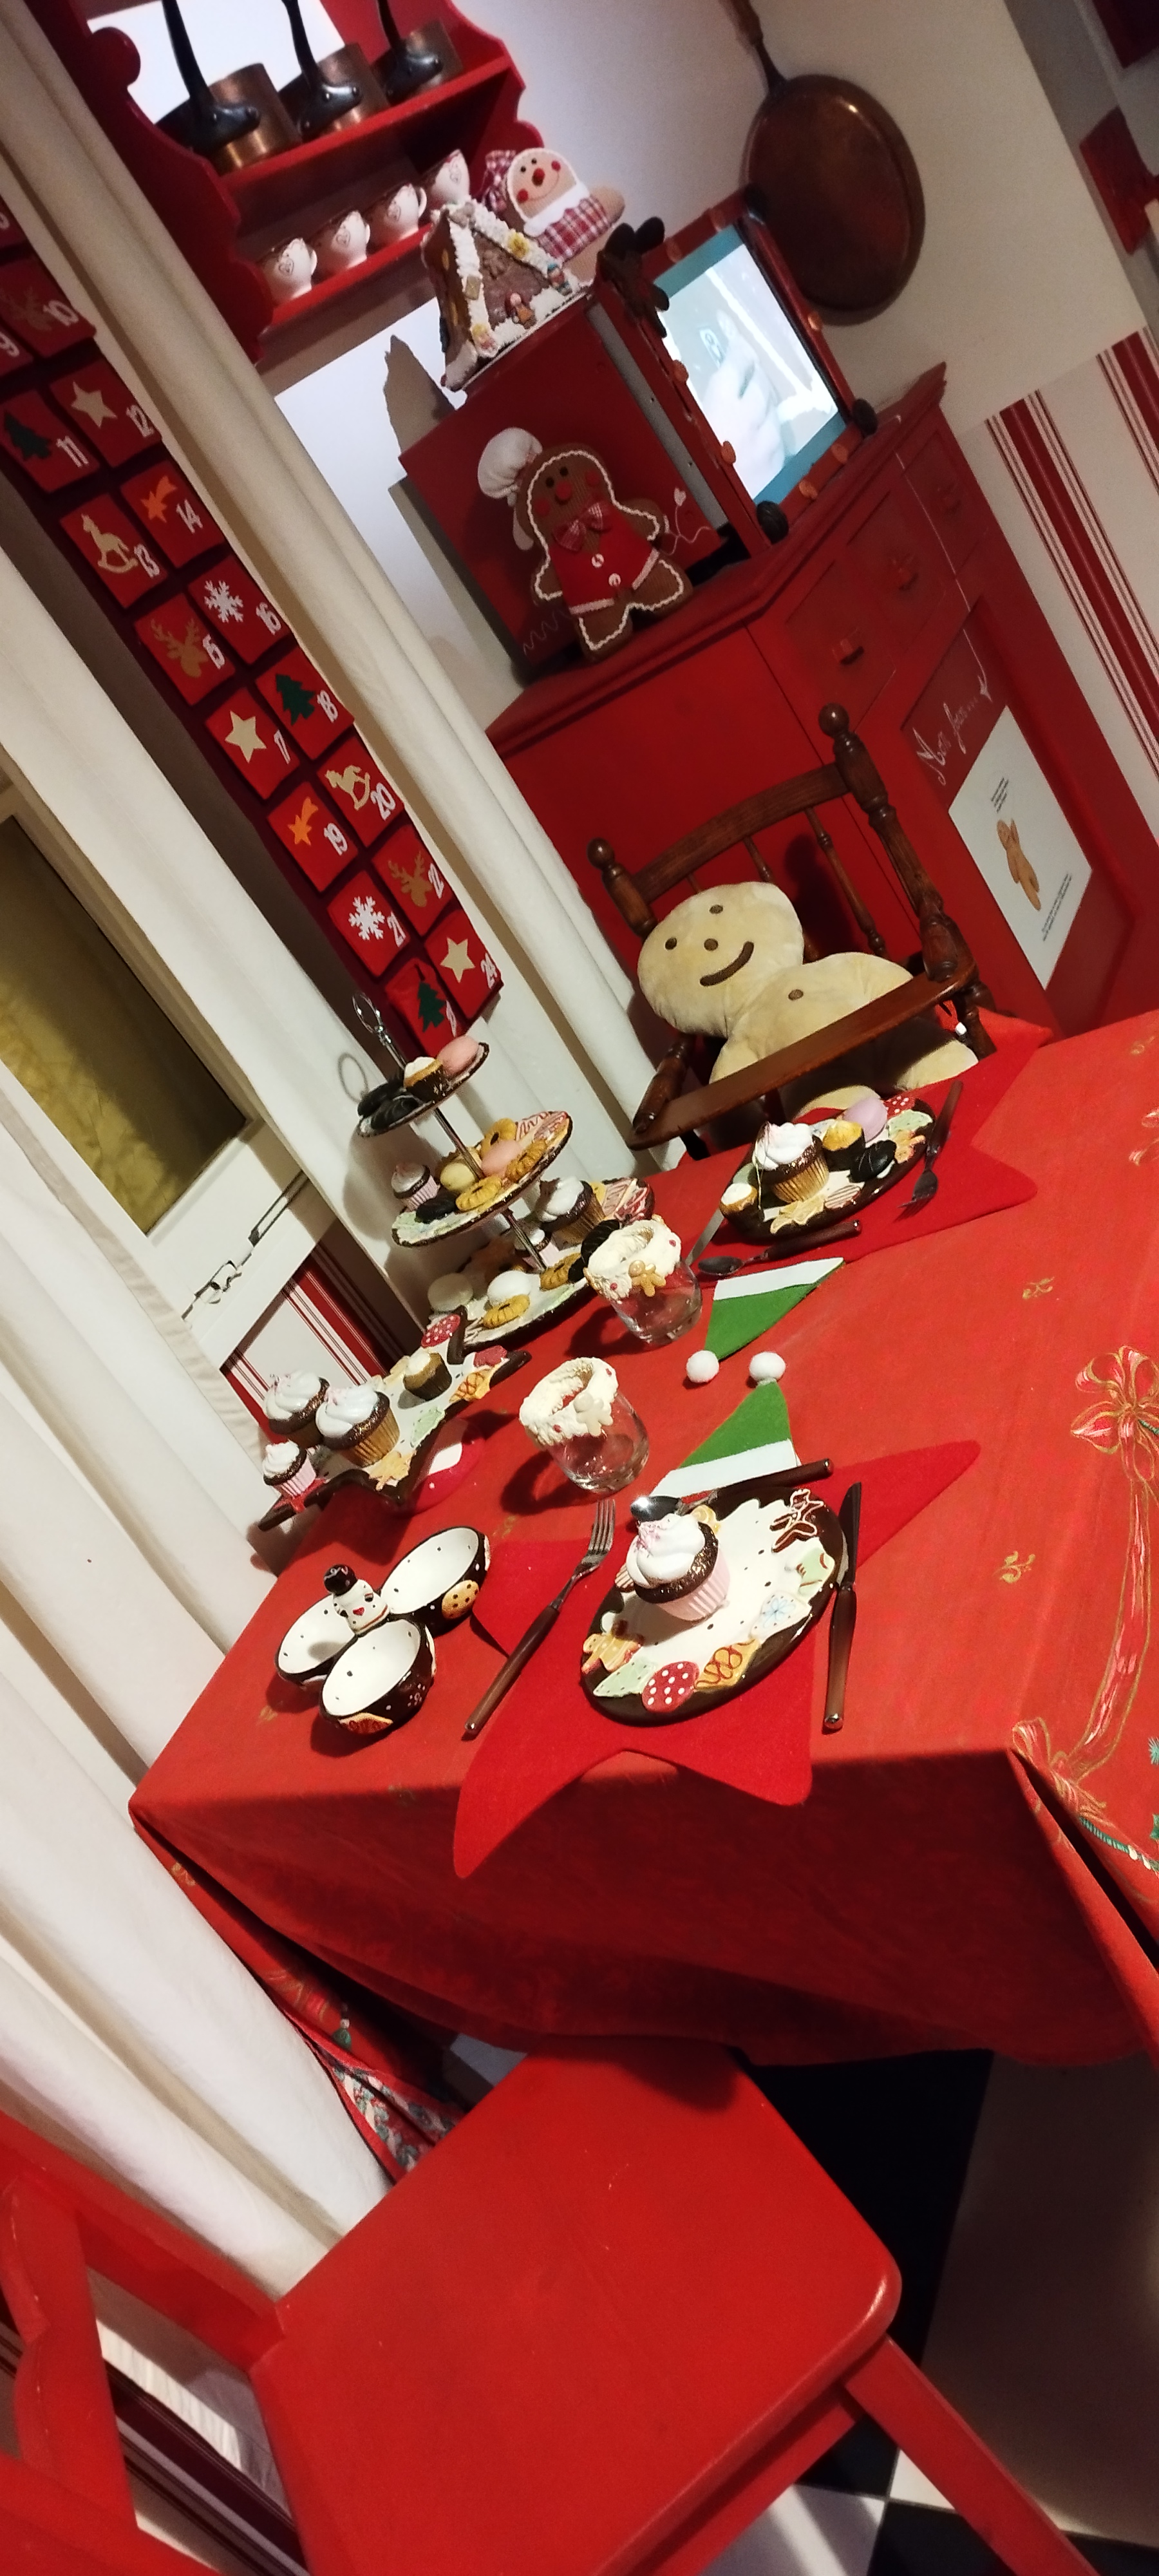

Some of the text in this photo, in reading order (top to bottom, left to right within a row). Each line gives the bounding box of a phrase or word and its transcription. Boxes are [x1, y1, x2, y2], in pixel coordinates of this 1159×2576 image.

[42, 300, 79, 326] 10
[126, 405, 155, 438] 12
[56, 436, 89, 467] 11
[176, 498, 203, 534] 14
[133, 543, 160, 578] 13
[256, 602, 281, 635] 16
[317, 690, 338, 723] 18
[370, 782, 395, 821] 20
[324, 822, 348, 856] 19
[387, 911, 406, 947] 21
[480, 952, 498, 989] 24
